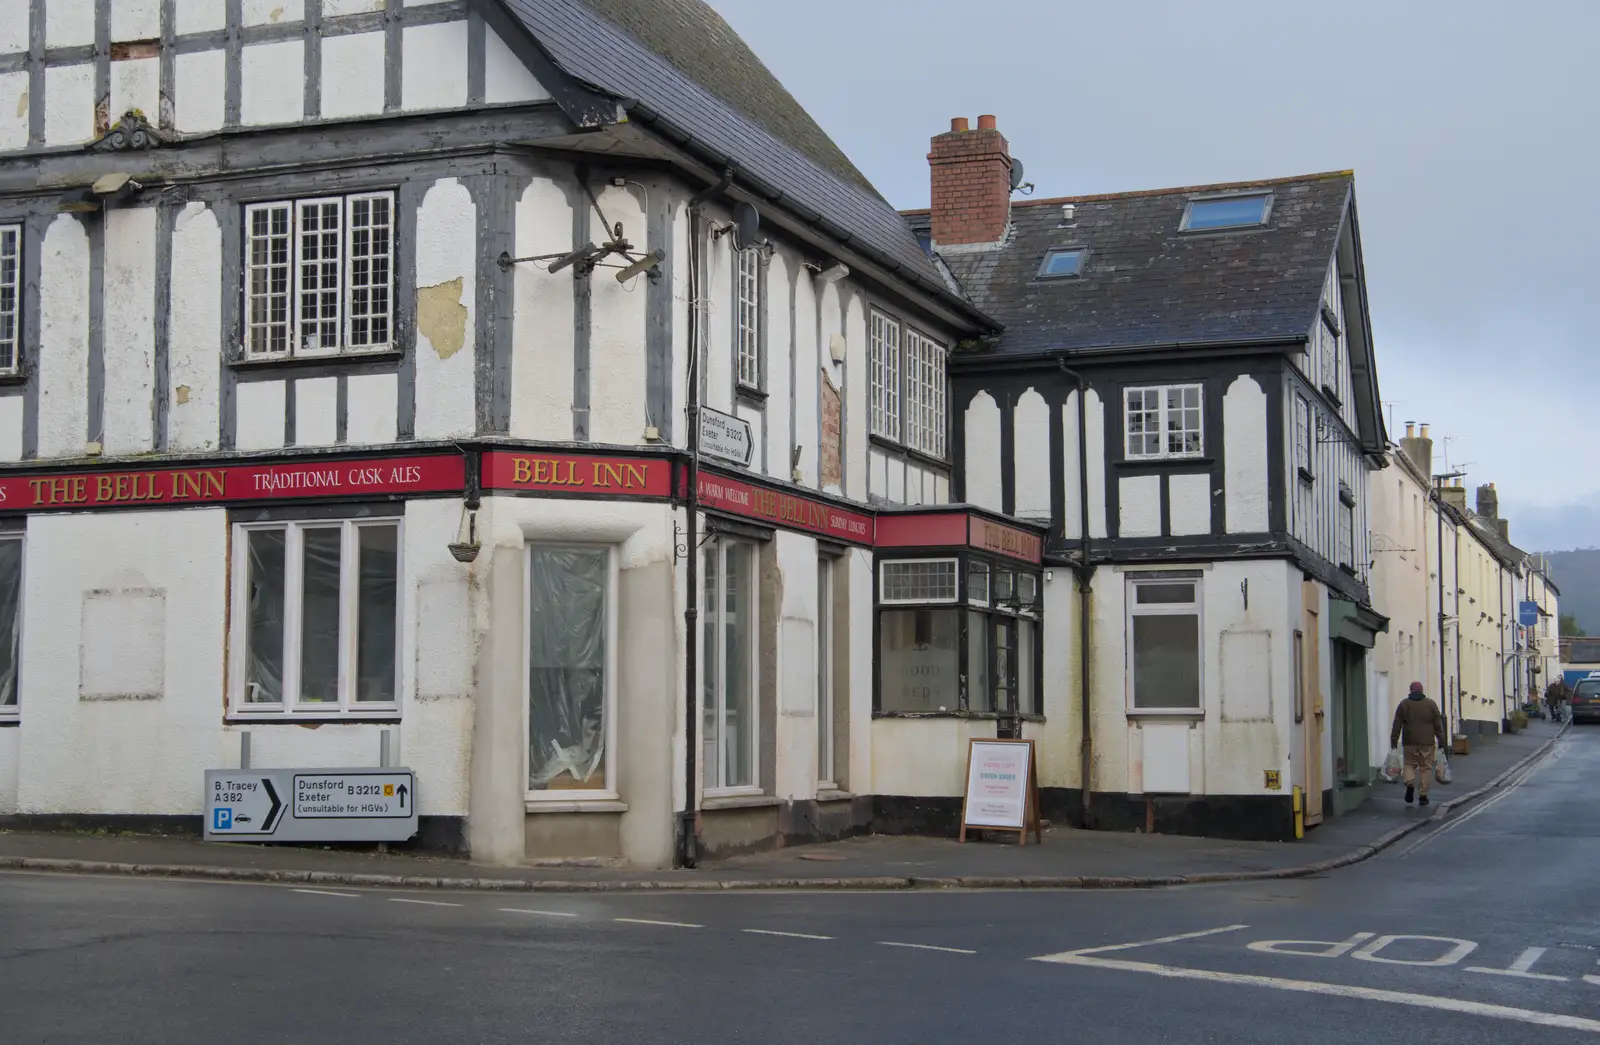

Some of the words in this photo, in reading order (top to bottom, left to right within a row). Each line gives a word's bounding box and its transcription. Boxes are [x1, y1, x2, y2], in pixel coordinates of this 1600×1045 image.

[702, 412, 726, 430] Dunsford
[702, 426, 719, 440] Exeter
[252, 469, 342, 491] TRADITIONAL
[348, 467, 383, 485] CASK
[389, 466, 421, 483] ALES
[512, 457, 584, 486] BELL
[592, 462, 648, 489] INN
[29, 476, 88, 505] THE
[95, 473, 164, 502] BELL
[171, 470, 227, 498] INN
[698, 481, 704, 494] A
[705, 484, 723, 499] WARM
[725, 488, 749, 506] WELCOME
[752, 489, 777, 517] THE
[779, 494, 806, 524] BELL
[808, 503, 830, 530] INN
[830, 515, 847, 530] SUNDAY
[848, 519, 866, 535] LUNCHES
[214, 781, 225, 791] B.
[227, 781, 258, 793] Tracey
[299, 780, 344, 790] Dunsford
[299, 792, 330, 802] Exeter
[297, 804, 344, 814] (unsuitable
[346, 804, 358, 813] for
[361, 804, 389, 814] HGVs)
[1246, 931, 1600, 986] TOP
